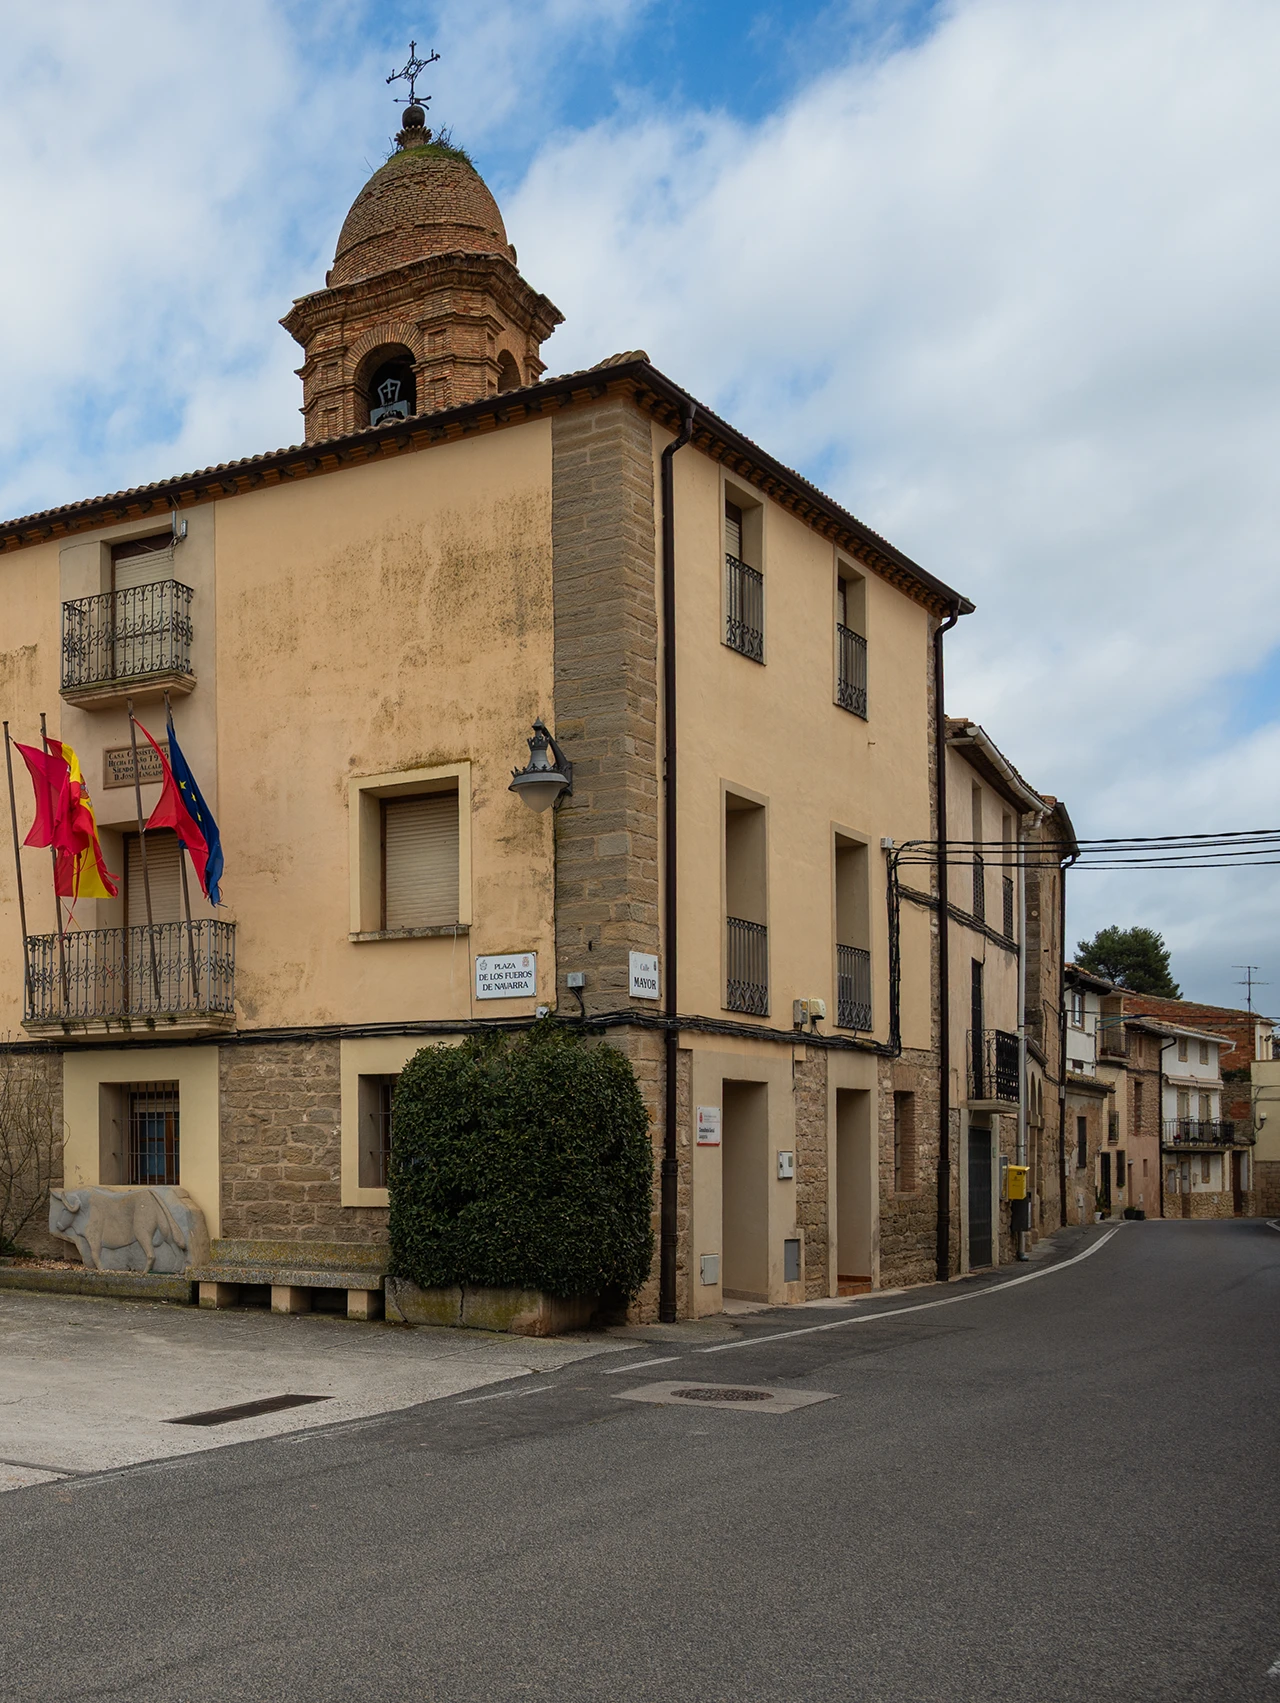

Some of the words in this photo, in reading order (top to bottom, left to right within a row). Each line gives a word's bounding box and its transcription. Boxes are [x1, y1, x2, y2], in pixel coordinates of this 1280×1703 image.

[494, 962, 516, 970] PLAZA
[479, 973, 489, 981] DE
[490, 972, 503, 980] LOS
[505, 970, 532, 979] FUEROS
[482, 983, 493, 991] DE
[494, 981, 529, 990] NAVARRA
[634, 976, 657, 990] MAYOR
